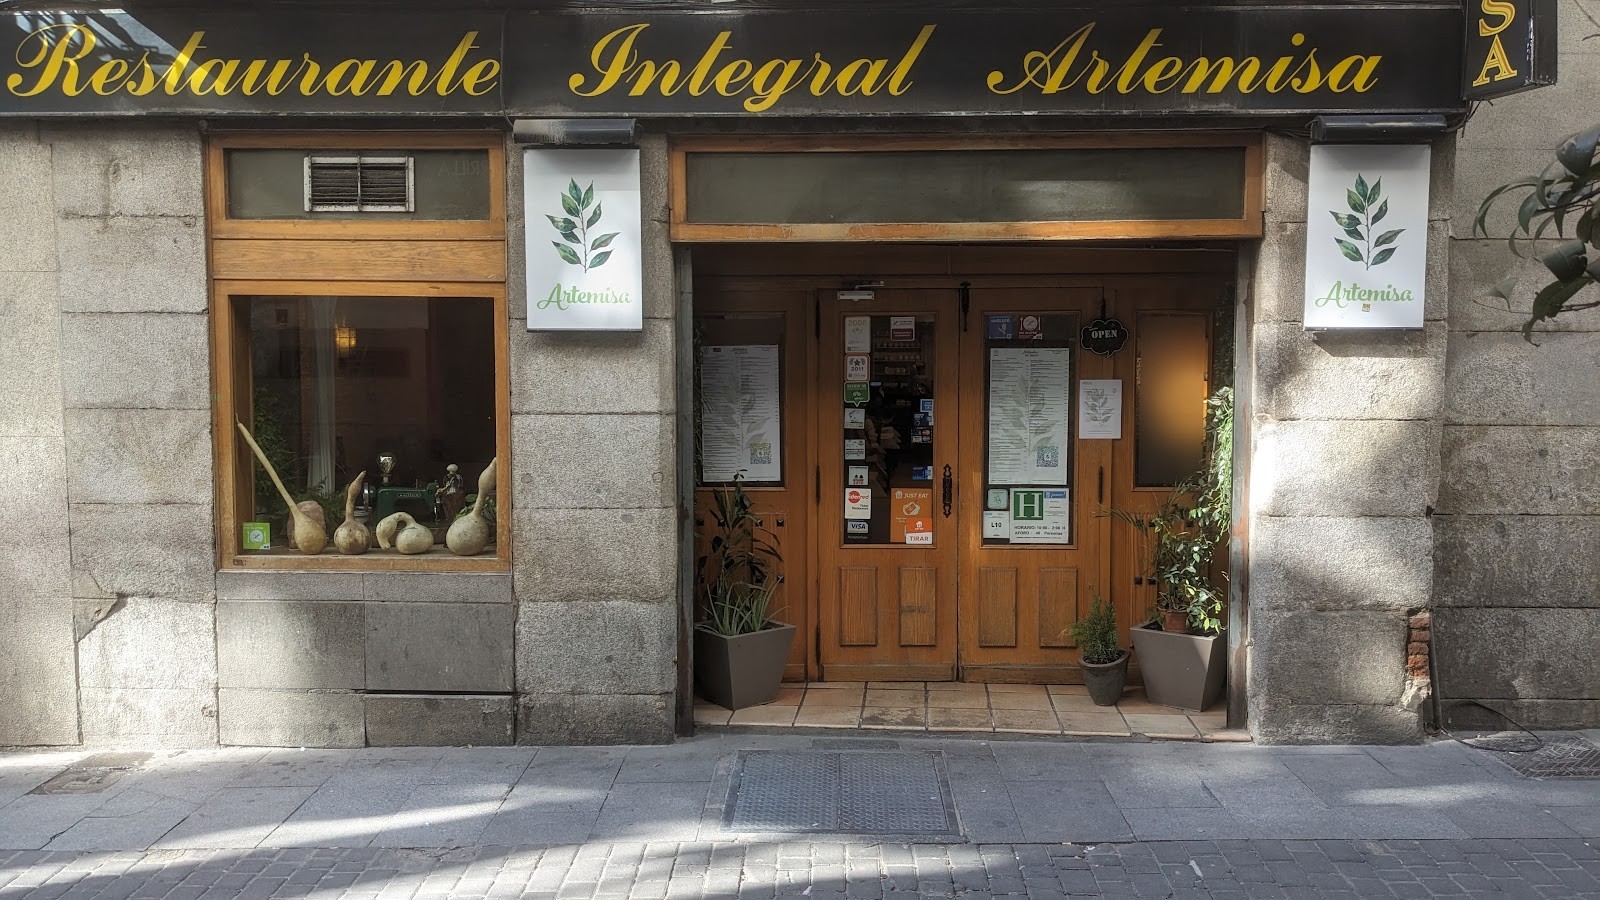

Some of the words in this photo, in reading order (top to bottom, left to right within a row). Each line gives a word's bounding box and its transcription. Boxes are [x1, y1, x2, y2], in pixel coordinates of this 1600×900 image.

[6, 23, 501, 97] Restaurante
[568, 23, 937, 113] Integral
[987, 21, 1383, 96] Artemisa
[536, 283, 632, 311] Artemisa
[1315, 280, 1414, 308] Artemisa
[1091, 329, 1118, 339] OPEN
[1016, 492, 1042, 518] H
